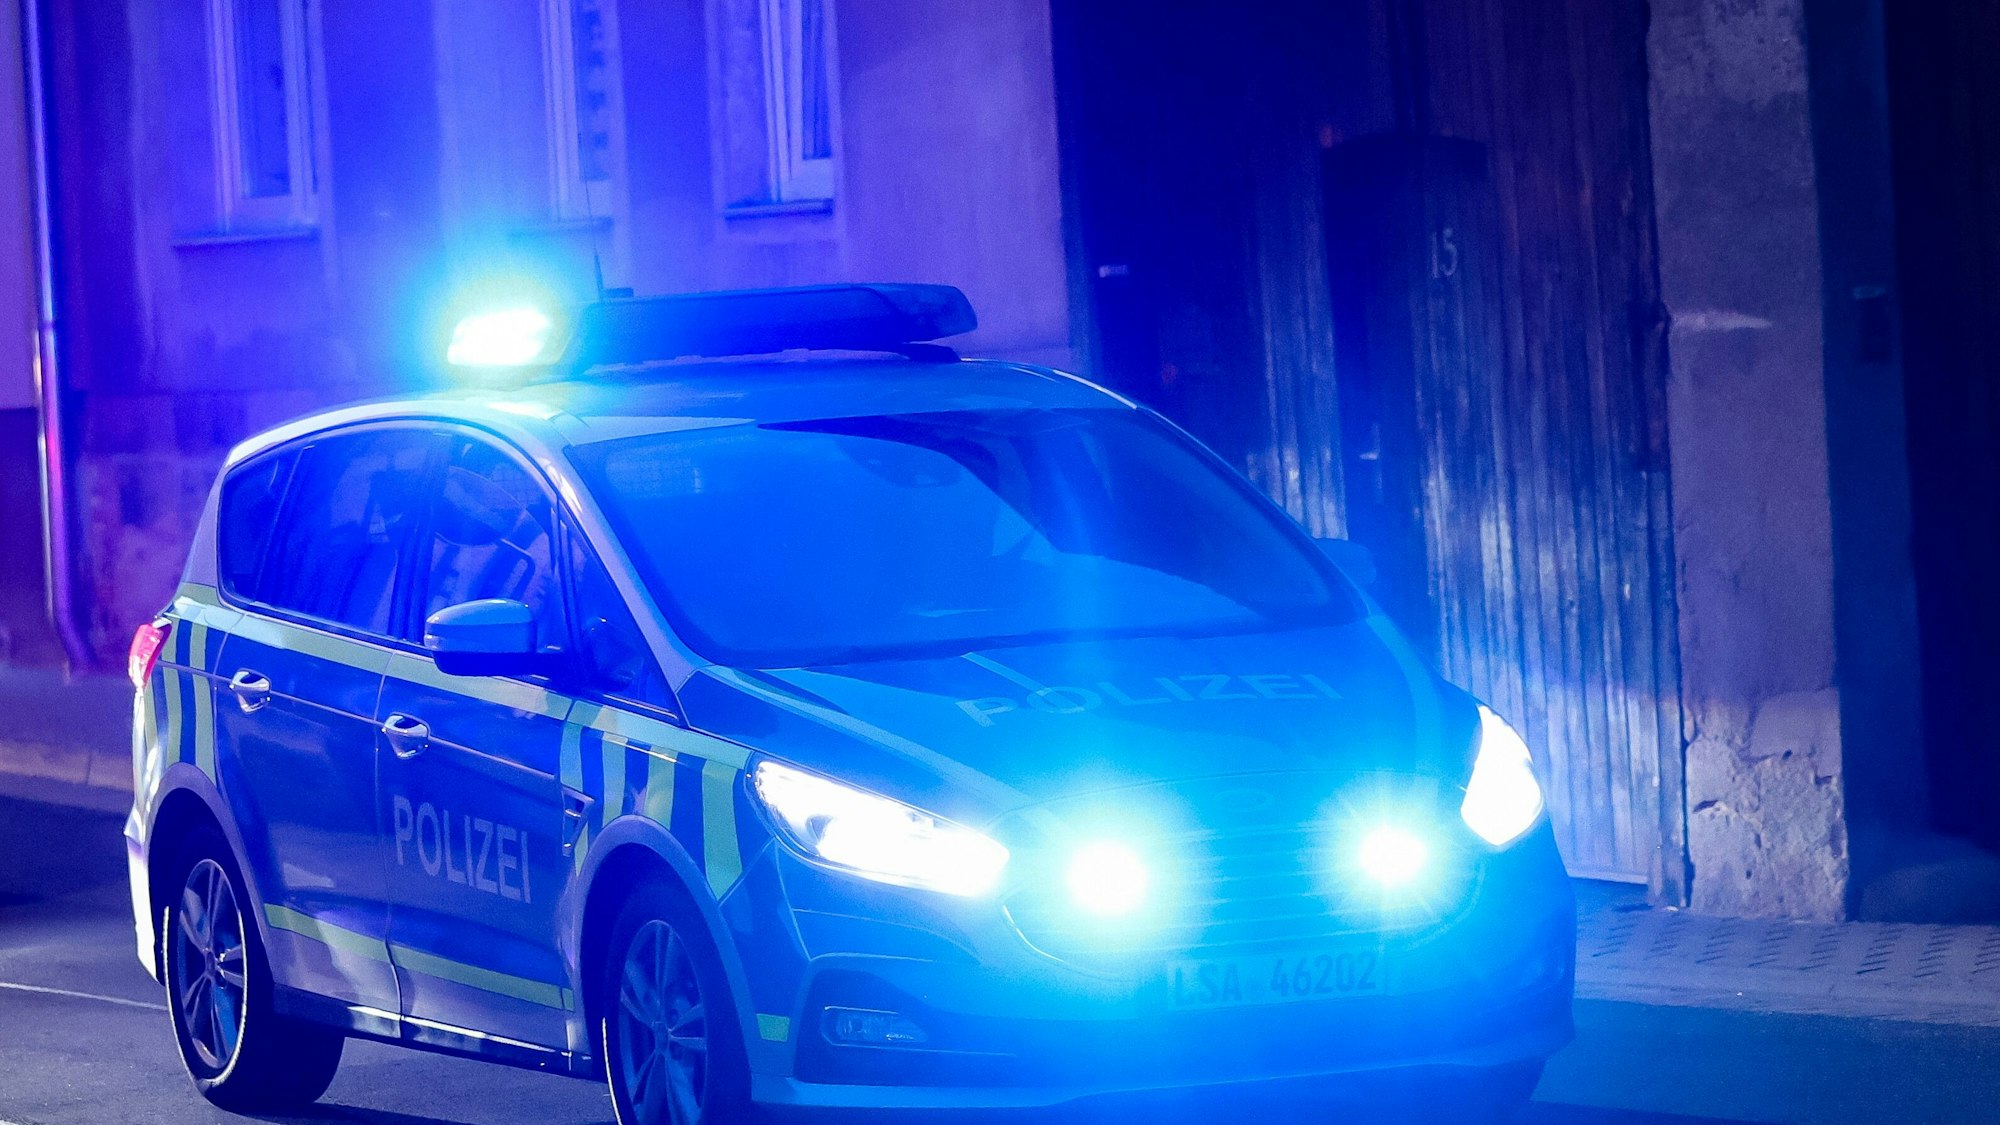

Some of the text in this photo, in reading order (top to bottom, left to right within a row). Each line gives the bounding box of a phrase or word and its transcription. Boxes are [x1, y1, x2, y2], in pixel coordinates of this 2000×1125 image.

[1431, 227, 1458, 279] 15
[954, 673, 1344, 727] POLIZEI
[393, 793, 532, 904] POLIZEI
[1175, 951, 1377, 1007] LSA 46202
